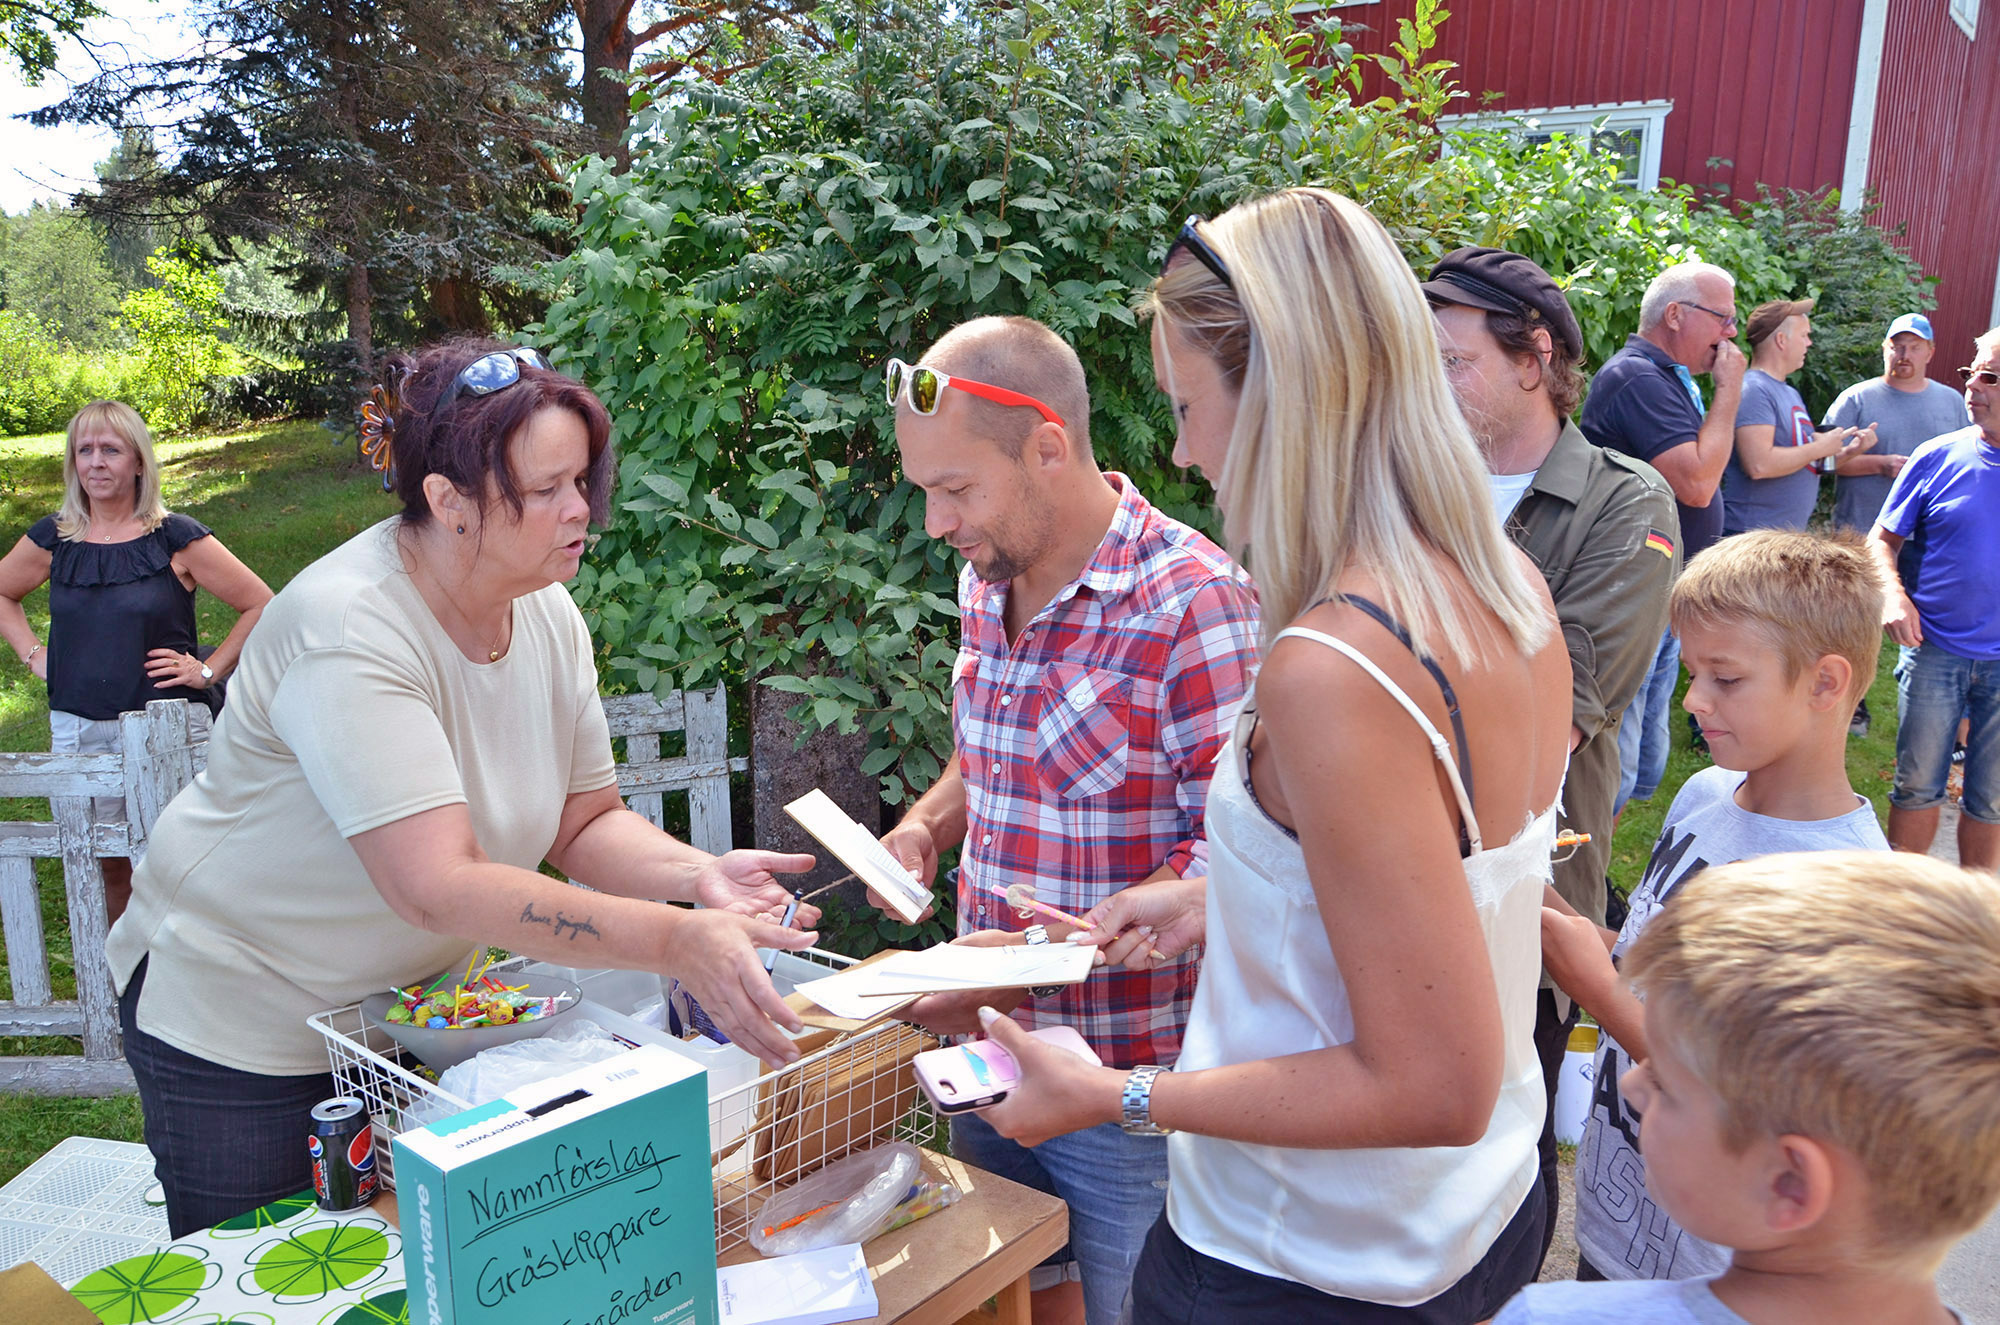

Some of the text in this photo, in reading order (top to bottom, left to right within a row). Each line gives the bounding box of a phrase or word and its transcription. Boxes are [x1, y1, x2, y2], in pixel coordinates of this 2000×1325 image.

[455, 1116, 539, 1149] Tupperware
[467, 1139, 665, 1225] Namnförslag
[417, 1183, 442, 1325] perware
[476, 1206, 673, 1308] Gräsklippare
[652, 1297, 695, 1323] Tupperware
